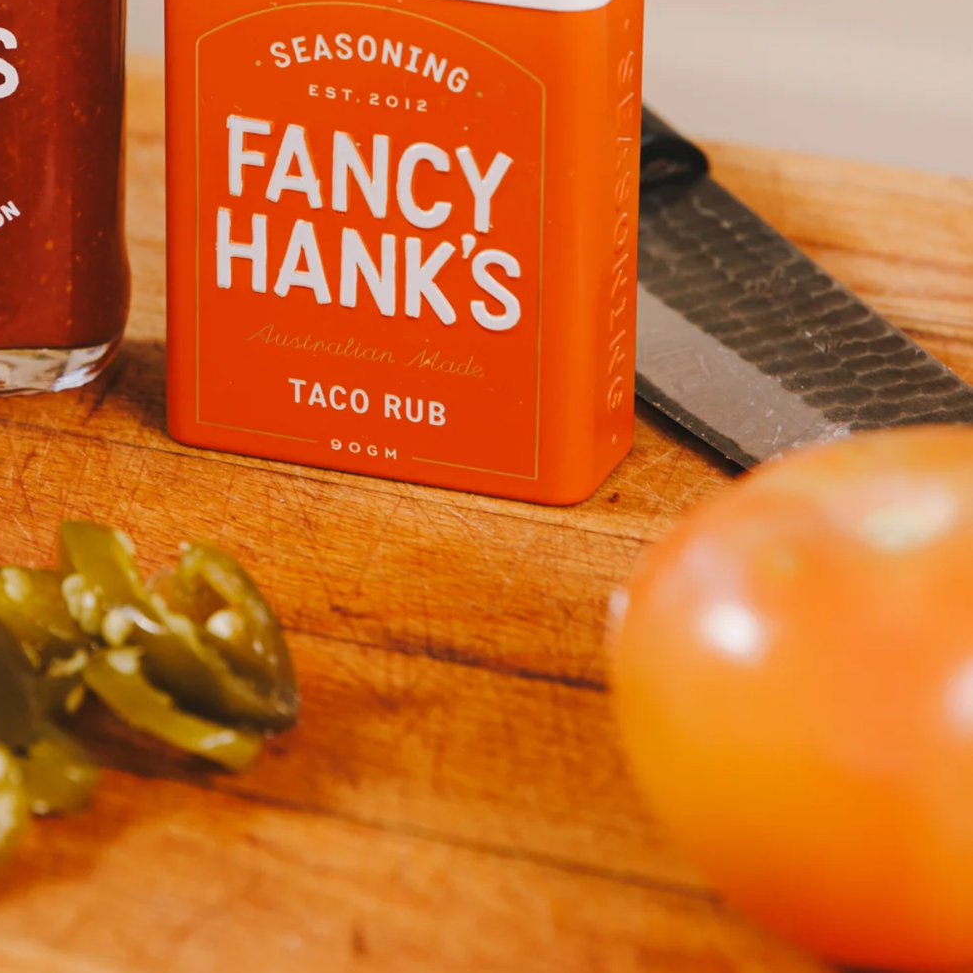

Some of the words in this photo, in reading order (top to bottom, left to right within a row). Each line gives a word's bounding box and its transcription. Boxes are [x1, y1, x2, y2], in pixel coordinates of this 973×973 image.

[270, 33, 469, 93] SEASONING
[227, 114, 514, 234] FANCY
[216, 206, 521, 331] HANK'S
[244, 324, 395, 363] Australian
[403, 348, 485, 377] Made
[289, 378, 370, 414] TACO
[384, 393, 446, 426] RUB
[331, 439, 397, 460] 90GM
